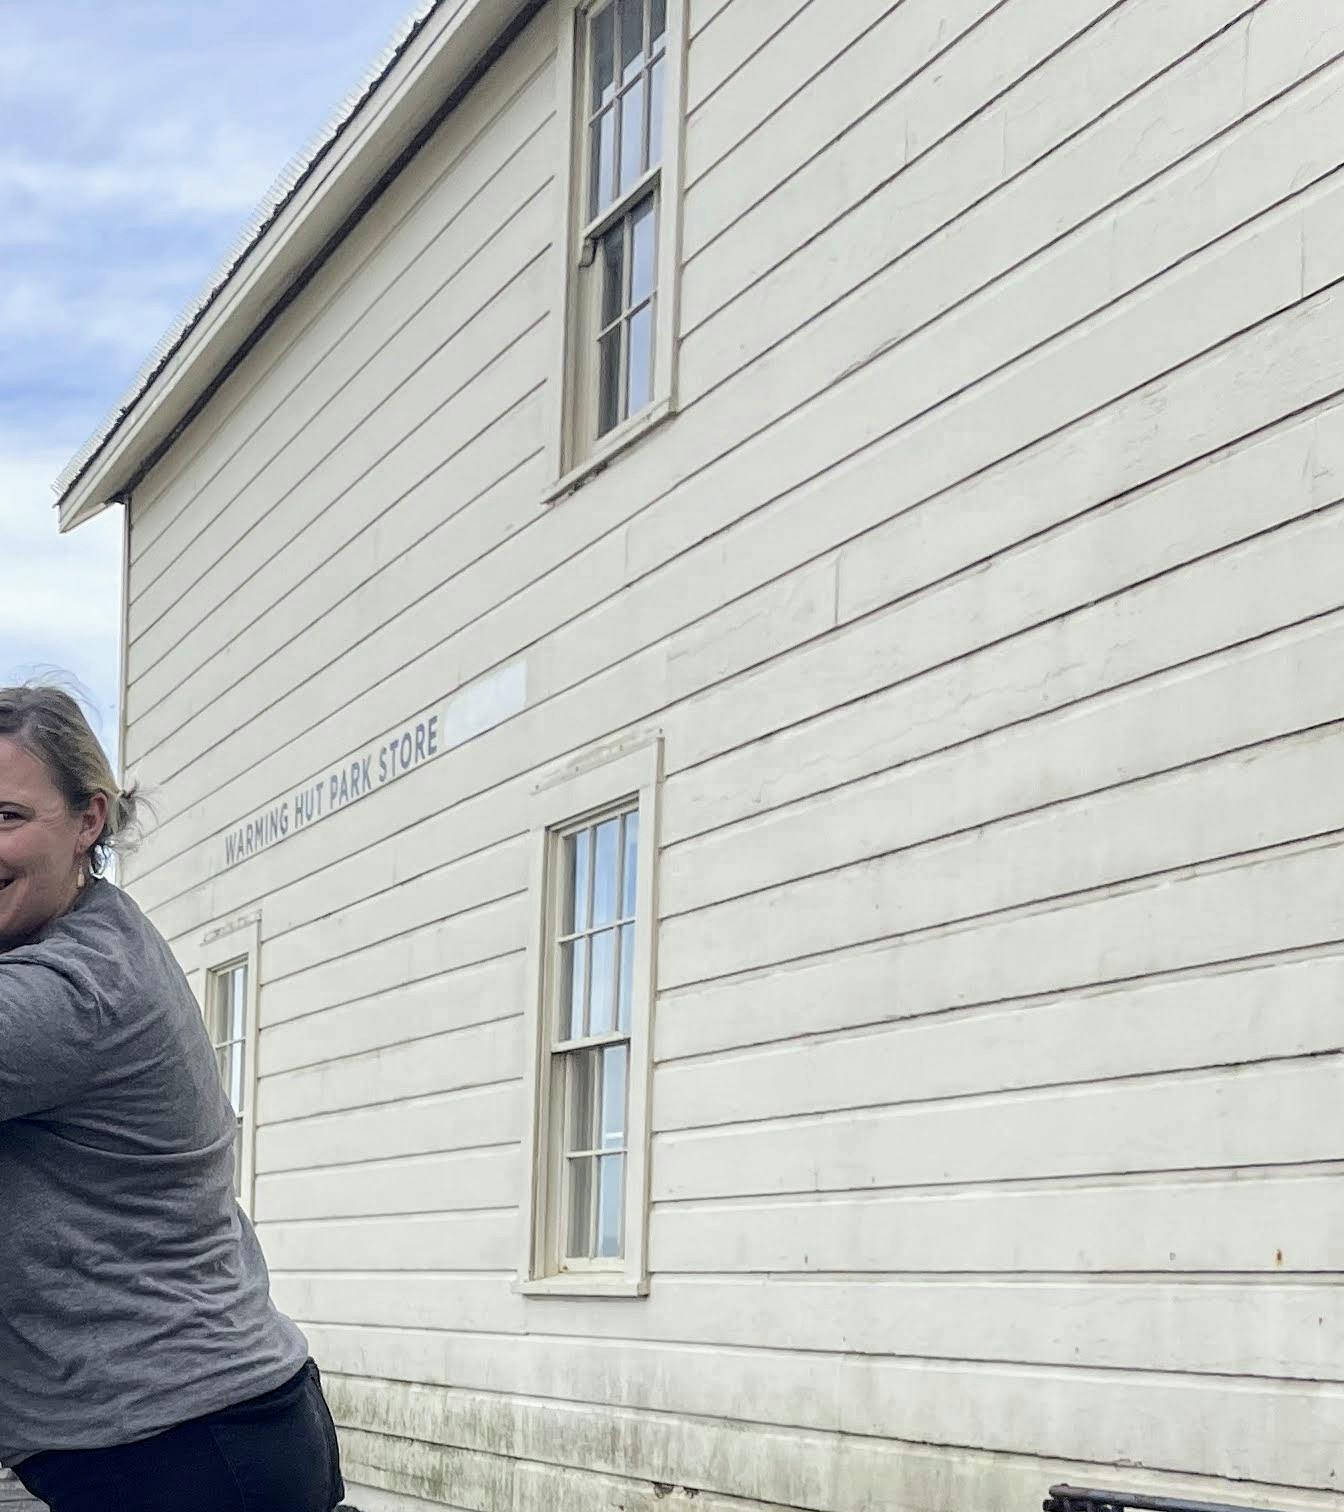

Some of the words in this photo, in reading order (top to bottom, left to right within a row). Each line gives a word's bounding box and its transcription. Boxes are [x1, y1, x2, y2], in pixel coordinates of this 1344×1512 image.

[224, 802, 289, 866] WARMING
[294, 781, 324, 829] HUT
[329, 754, 372, 810] PARK
[378, 715, 438, 783] STORE
